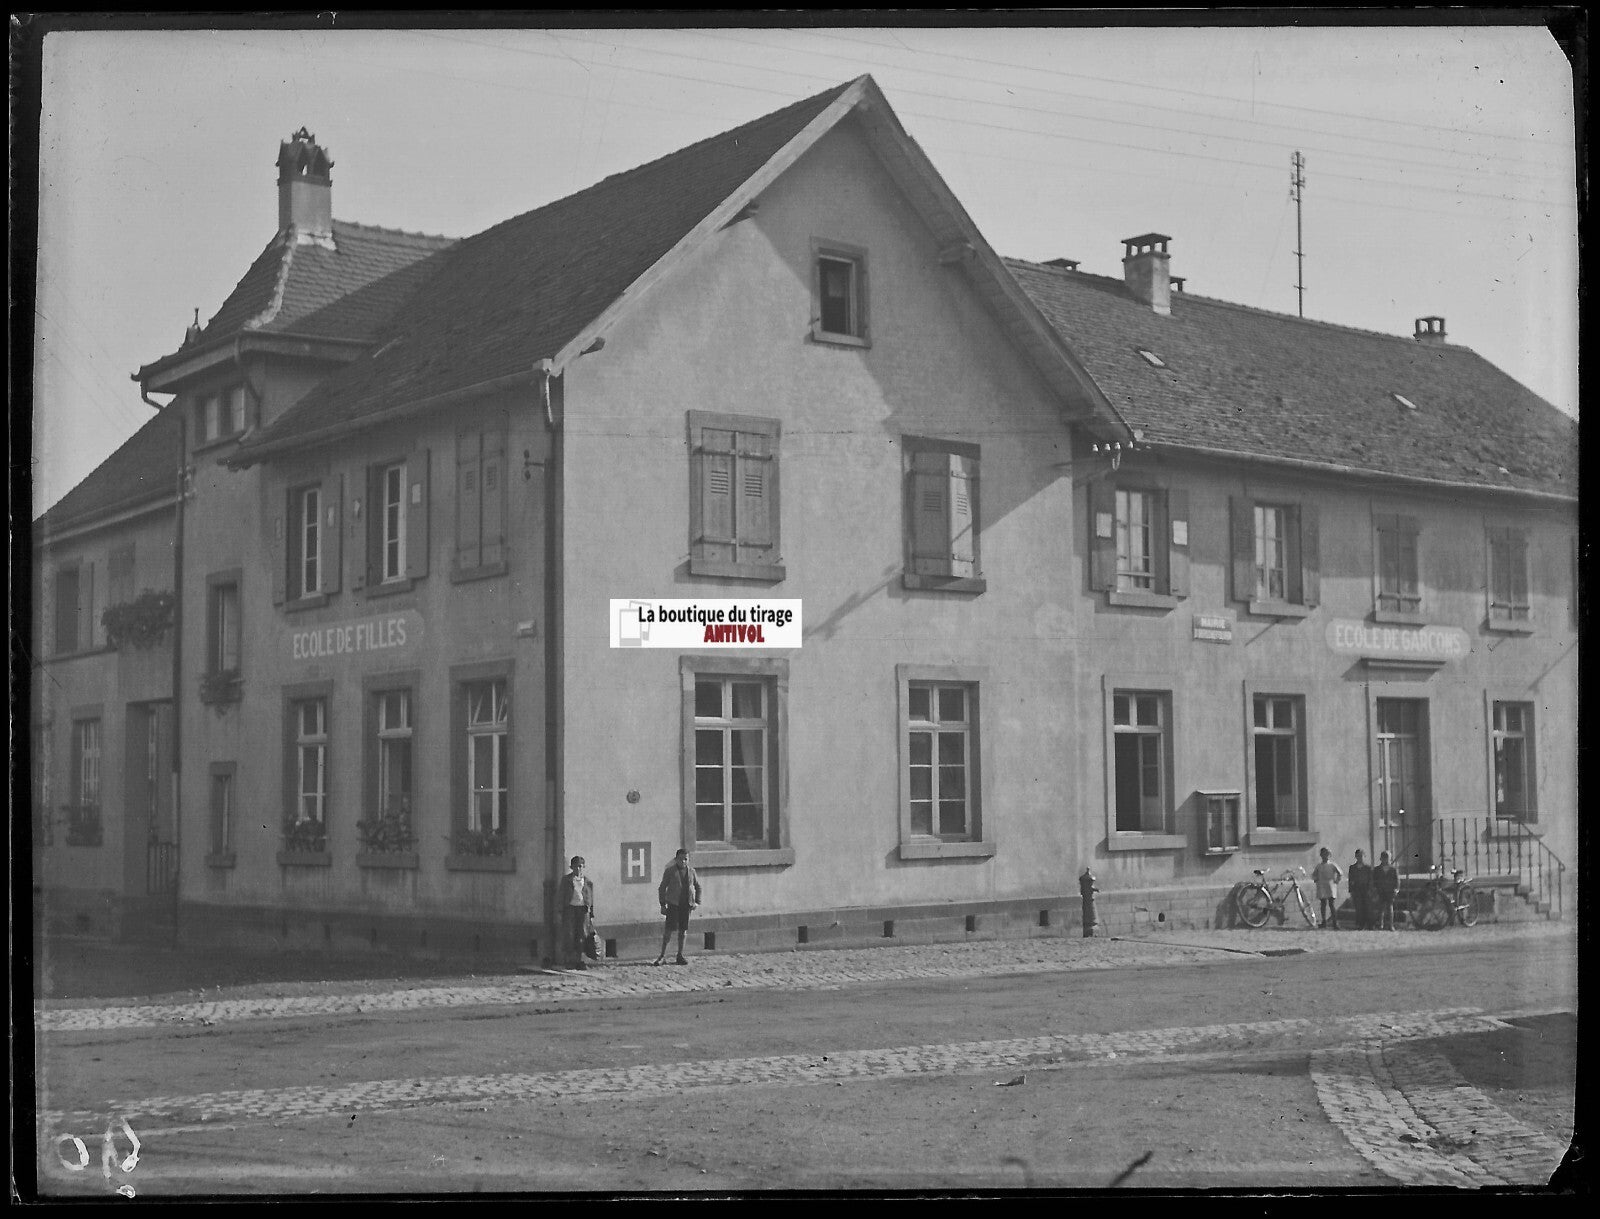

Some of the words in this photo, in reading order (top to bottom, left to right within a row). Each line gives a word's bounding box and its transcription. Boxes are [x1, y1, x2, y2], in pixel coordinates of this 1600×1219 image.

[293, 629, 335, 659] ECOLE
[336, 625, 354, 653] DE
[356, 618, 406, 651] FILLES
[1335, 624, 1381, 649] ECOLE
[1383, 627, 1399, 649] DE
[627, 848, 645, 878] H
